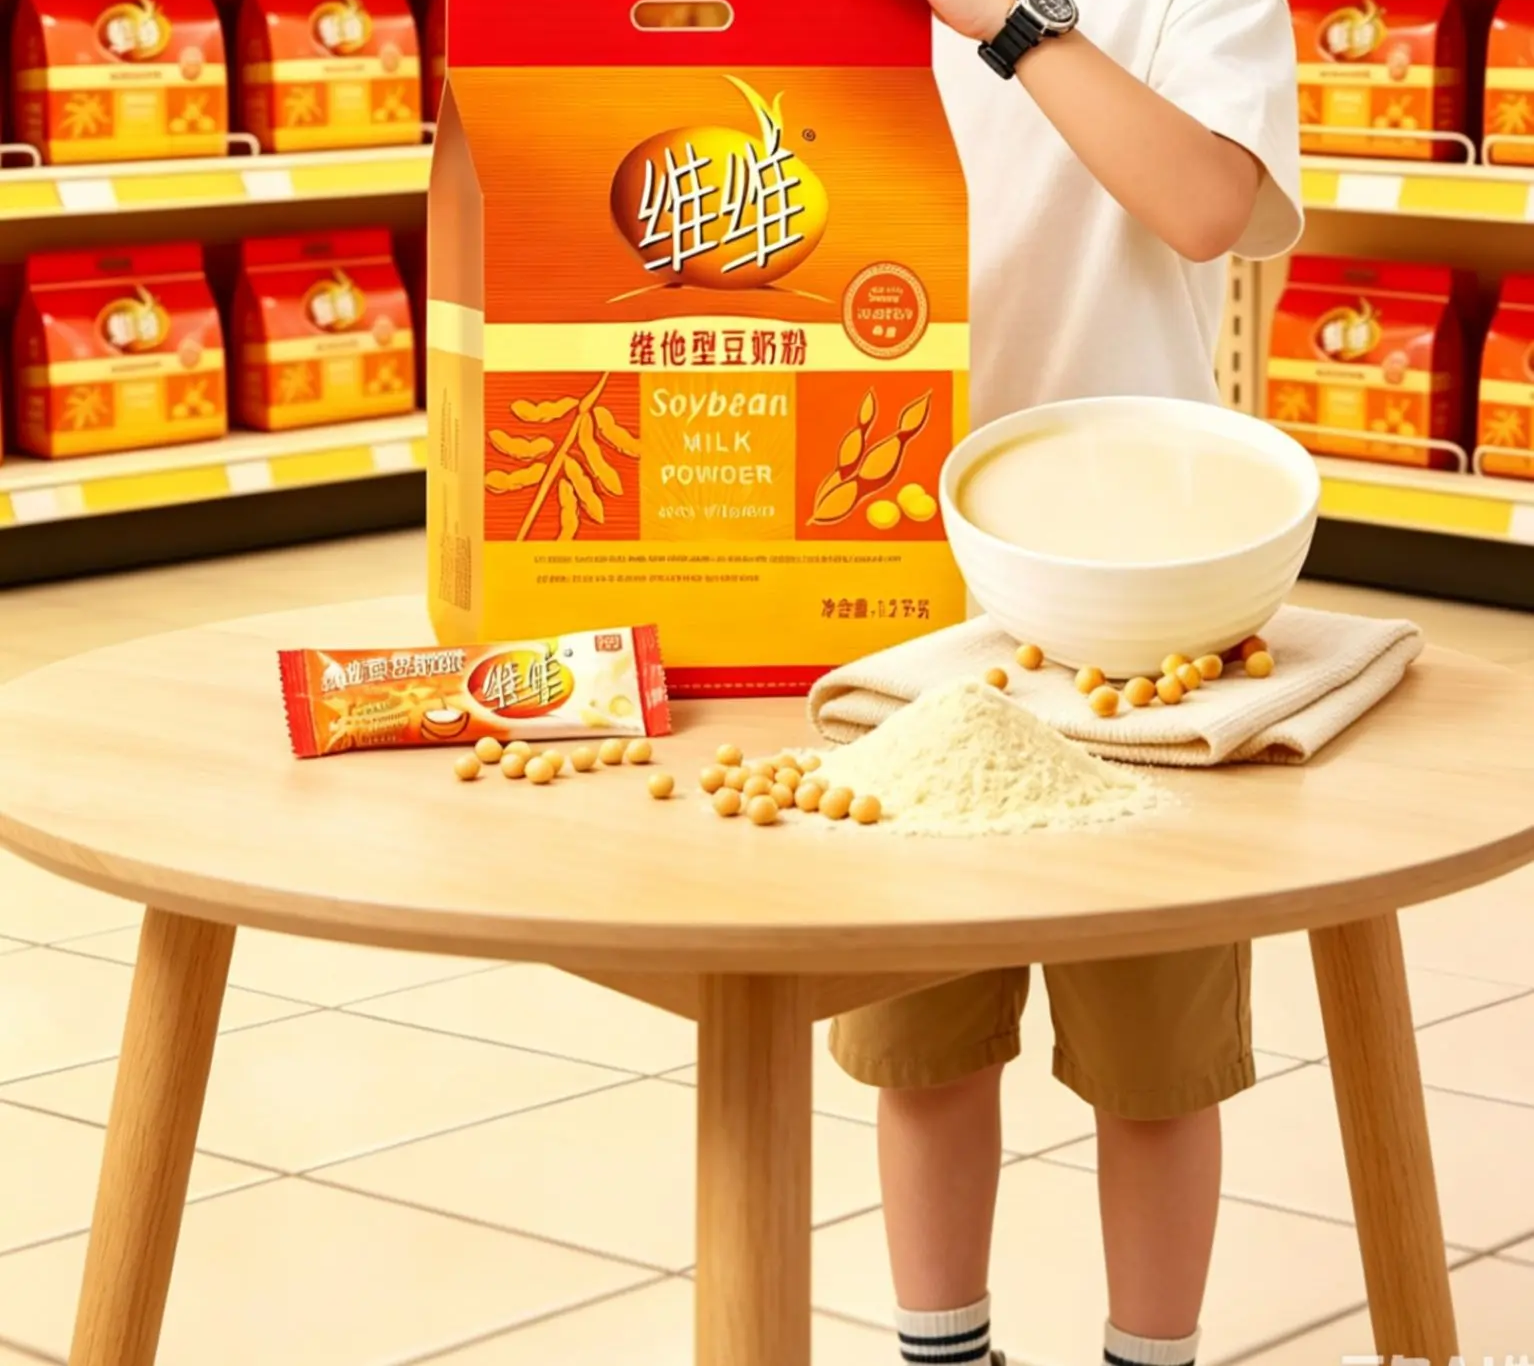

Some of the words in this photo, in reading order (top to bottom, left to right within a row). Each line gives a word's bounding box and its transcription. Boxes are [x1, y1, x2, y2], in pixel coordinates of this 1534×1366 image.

[637, 116, 806, 275] 维维
[629, 328, 807, 367] 维他型豆奶粉
[650, 388, 788, 425] Soybean
[683, 431, 751, 453] MILK
[660, 464, 773, 486] POWDER
